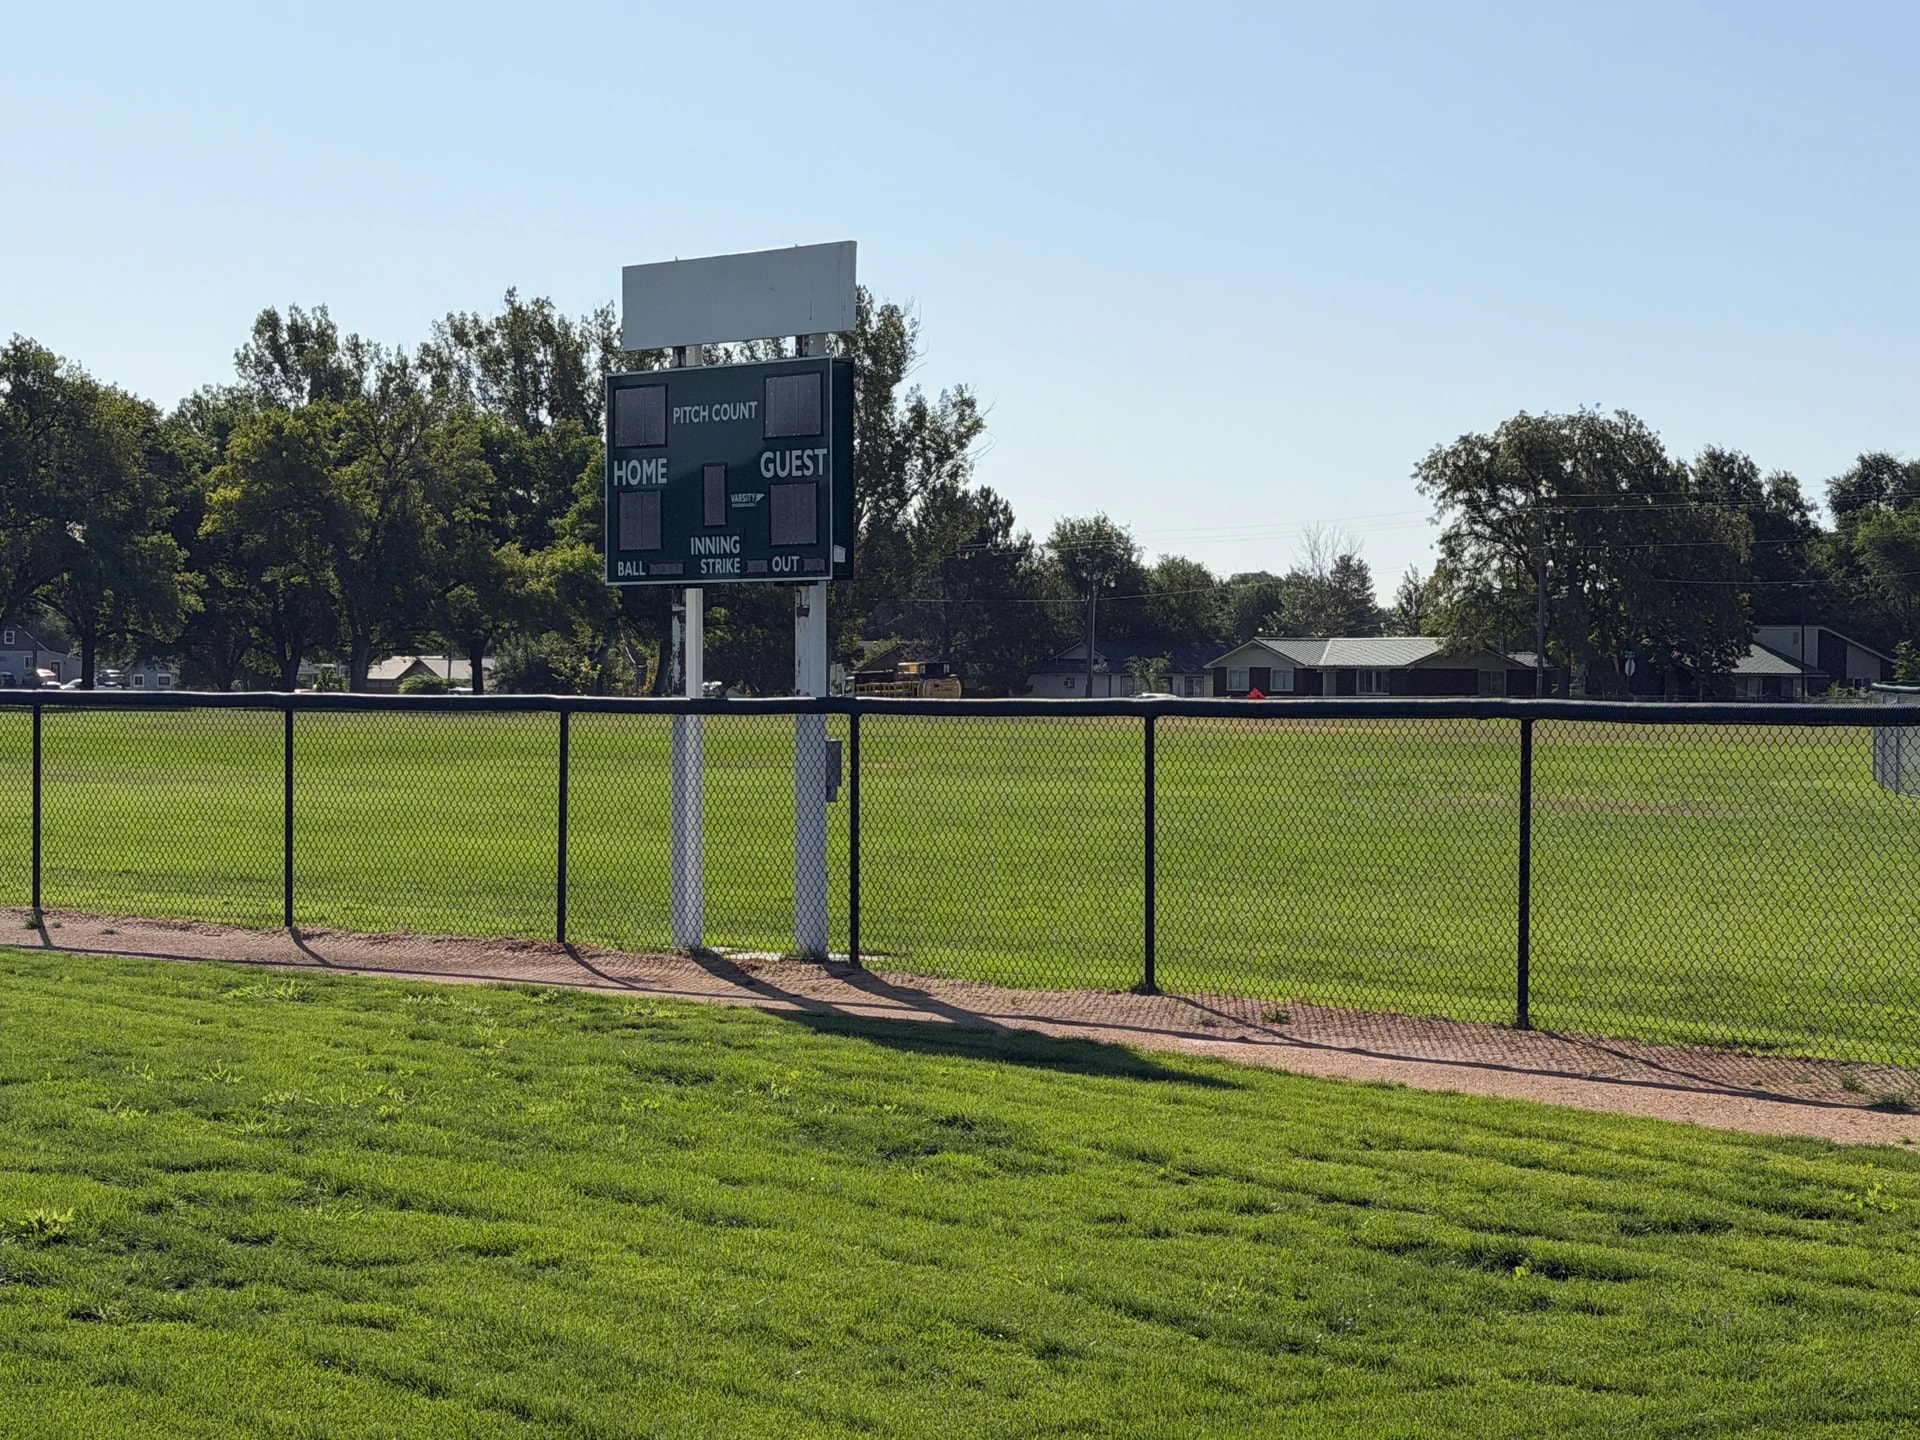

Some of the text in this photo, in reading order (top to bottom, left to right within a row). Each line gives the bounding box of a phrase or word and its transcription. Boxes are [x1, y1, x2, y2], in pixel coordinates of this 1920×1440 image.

[673, 401, 758, 425] PITCH COUNT
[613, 458, 668, 487] HOME
[760, 448, 828, 479] GUEST
[731, 493, 757, 503] VARSITY
[690, 535, 741, 555] INNING
[617, 561, 646, 577] BALL
[700, 558, 741, 575] STRIKE
[771, 556, 800, 572] OUT
